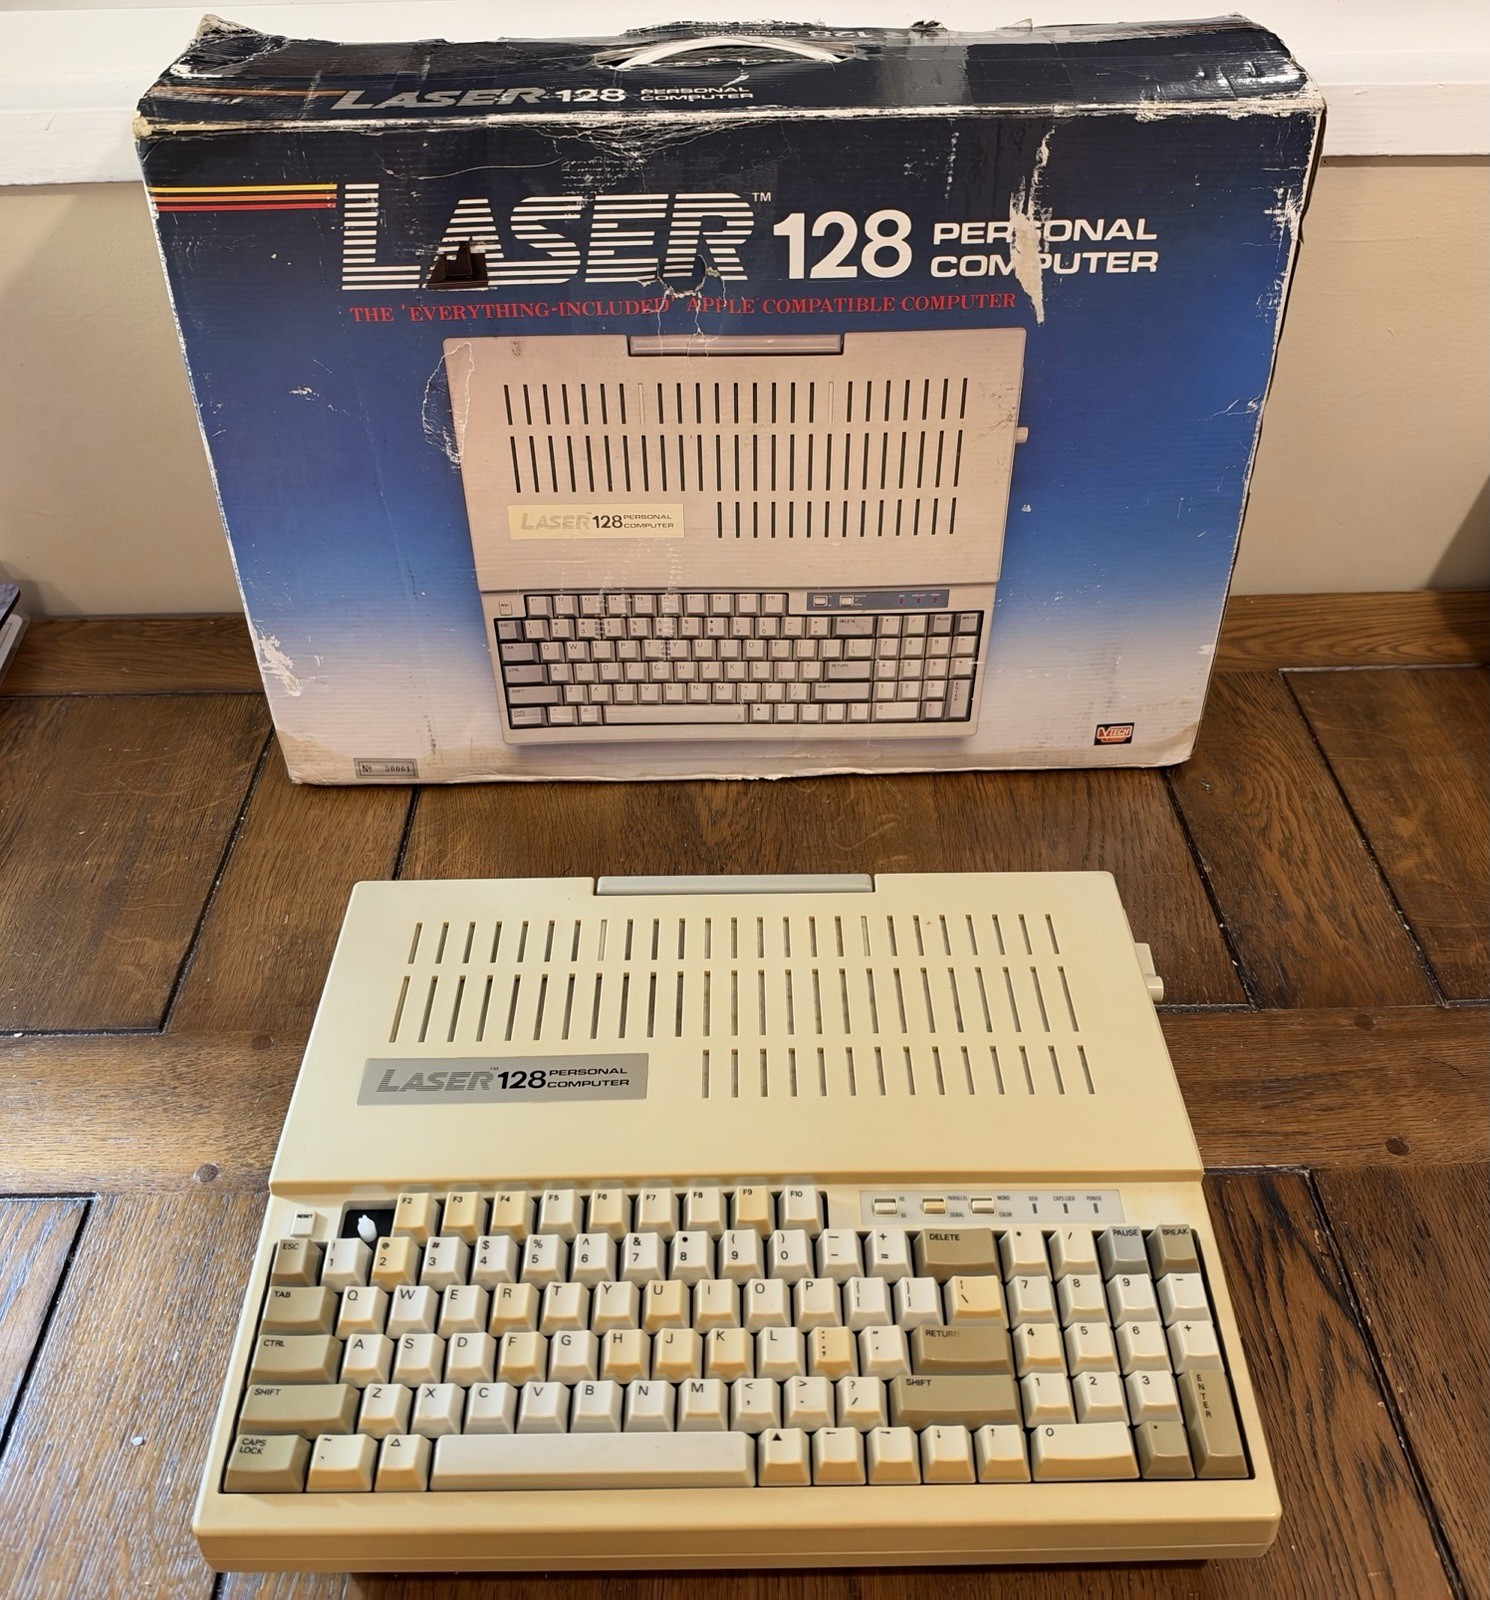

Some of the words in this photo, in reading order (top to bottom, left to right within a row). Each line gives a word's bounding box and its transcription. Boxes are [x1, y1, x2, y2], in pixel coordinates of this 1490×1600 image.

[330, 87, 546, 110] LASER
[555, 88, 626, 102] 128
[640, 93, 753, 101] COMPUTER
[641, 87, 750, 95] PERSONAL
[342, 184, 754, 291] LASER
[752, 192, 771, 202] TM
[773, 209, 912, 280] 128
[933, 218, 1158, 246] PERONAL
[350, 305, 395, 323] THE
[401, 296, 674, 322] 'EVERYTHING-INCLUDED'
[686, 297, 755, 315] APPLE
[762, 296, 895, 315] COMPATIBLE
[901, 293, 1016, 312] COMPUTER
[520, 512, 591, 531] LASER
[592, 515, 623, 529] 128
[376, 1069, 494, 1093] LASER
[497, 1070, 547, 1090] 128
[549, 1068, 627, 1076] PERSONAL
[547, 1079, 630, 1088] COMPUTER
[742, 1188, 753, 1196] F9
[790, 1190, 803, 1198] F10
[282, 1242, 298, 1250] ESC
[929, 1233, 960, 1241] DELETE
[1113, 1229, 1139, 1237] PAUSE
[1162, 1228, 1188, 1236] BREAK
[379, 1258, 386, 1266] 2
[429, 1257, 436, 1266] 3
[480, 1256, 488, 1264] 4
[532, 1255, 538, 1263] 5
[582, 1254, 588, 1262] 6
[632, 1254, 639, 1262] 7
[680, 1252, 687, 1260] 8
[732, 1252, 738, 1260] 9
[780, 1252, 788, 1260] 0
[274, 1290, 291, 1298] TAB
[348, 1290, 358, 1301] Q
[400, 1289, 416, 1299] W
[450, 1290, 458, 1299] E
[502, 1288, 512, 1298] R
[553, 1286, 562, 1296] T
[602, 1285, 612, 1294] Y
[654, 1285, 663, 1295] U
[755, 1283, 765, 1294] O
[806, 1281, 814, 1290] P
[1021, 1280, 1028, 1288] 7
[1073, 1279, 1080, 1288] 8
[1122, 1278, 1130, 1287] 9
[354, 1340, 364, 1348] A
[404, 1338, 414, 1348] S
[457, 1337, 468, 1347] D
[508, 1337, 516, 1346] F
[561, 1335, 572, 1346] G
[613, 1334, 622, 1344] H
[666, 1334, 673, 1344] J
[716, 1330, 725, 1340] K
[770, 1330, 777, 1340] L
[1027, 1328, 1034, 1336] 4
[1081, 1326, 1088, 1335] 5
[1132, 1326, 1140, 1335] 6
[254, 1388, 281, 1396] SHIFT
[372, 1388, 382, 1398] Z
[425, 1388, 436, 1398] X
[478, 1388, 488, 1398] C
[534, 1387, 543, 1396] V
[586, 1385, 594, 1395] B
[638, 1386, 648, 1396] N
[691, 1382, 704, 1392] M
[906, 1379, 932, 1387] SHIFT
[1090, 1376, 1097, 1385] 2
[1142, 1375, 1150, 1385] 3
[1196, 1374, 1212, 1418] ENTER
[242, 1438, 266, 1446] CAPS
[1046, 1428, 1054, 1437] 0
